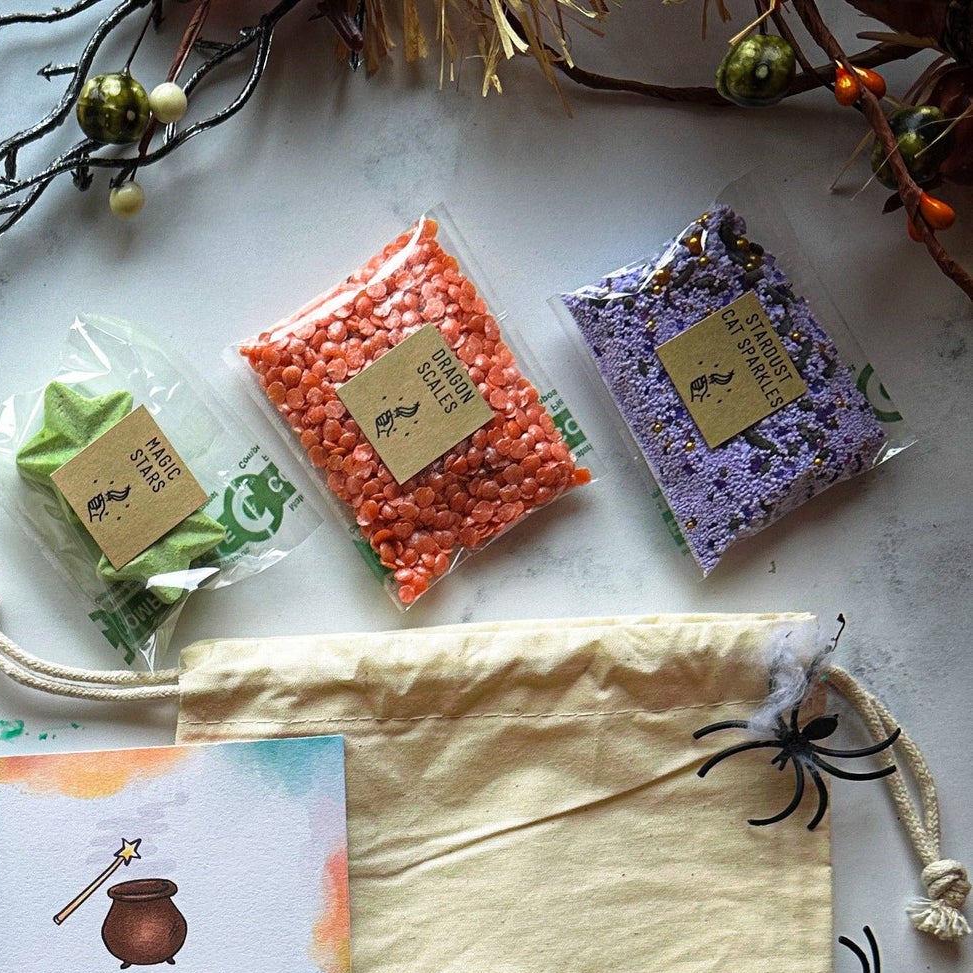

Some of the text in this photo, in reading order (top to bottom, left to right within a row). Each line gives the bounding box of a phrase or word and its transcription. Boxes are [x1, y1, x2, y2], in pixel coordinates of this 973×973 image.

[721, 308, 784, 408] CAT SPARKLES
[745, 312, 793, 383] STARDUST
[416, 361, 458, 413] SCALES
[431, 347, 475, 404] DRAGON
[130, 448, 165, 493] STARS
[145, 436, 181, 480] MAGIC
